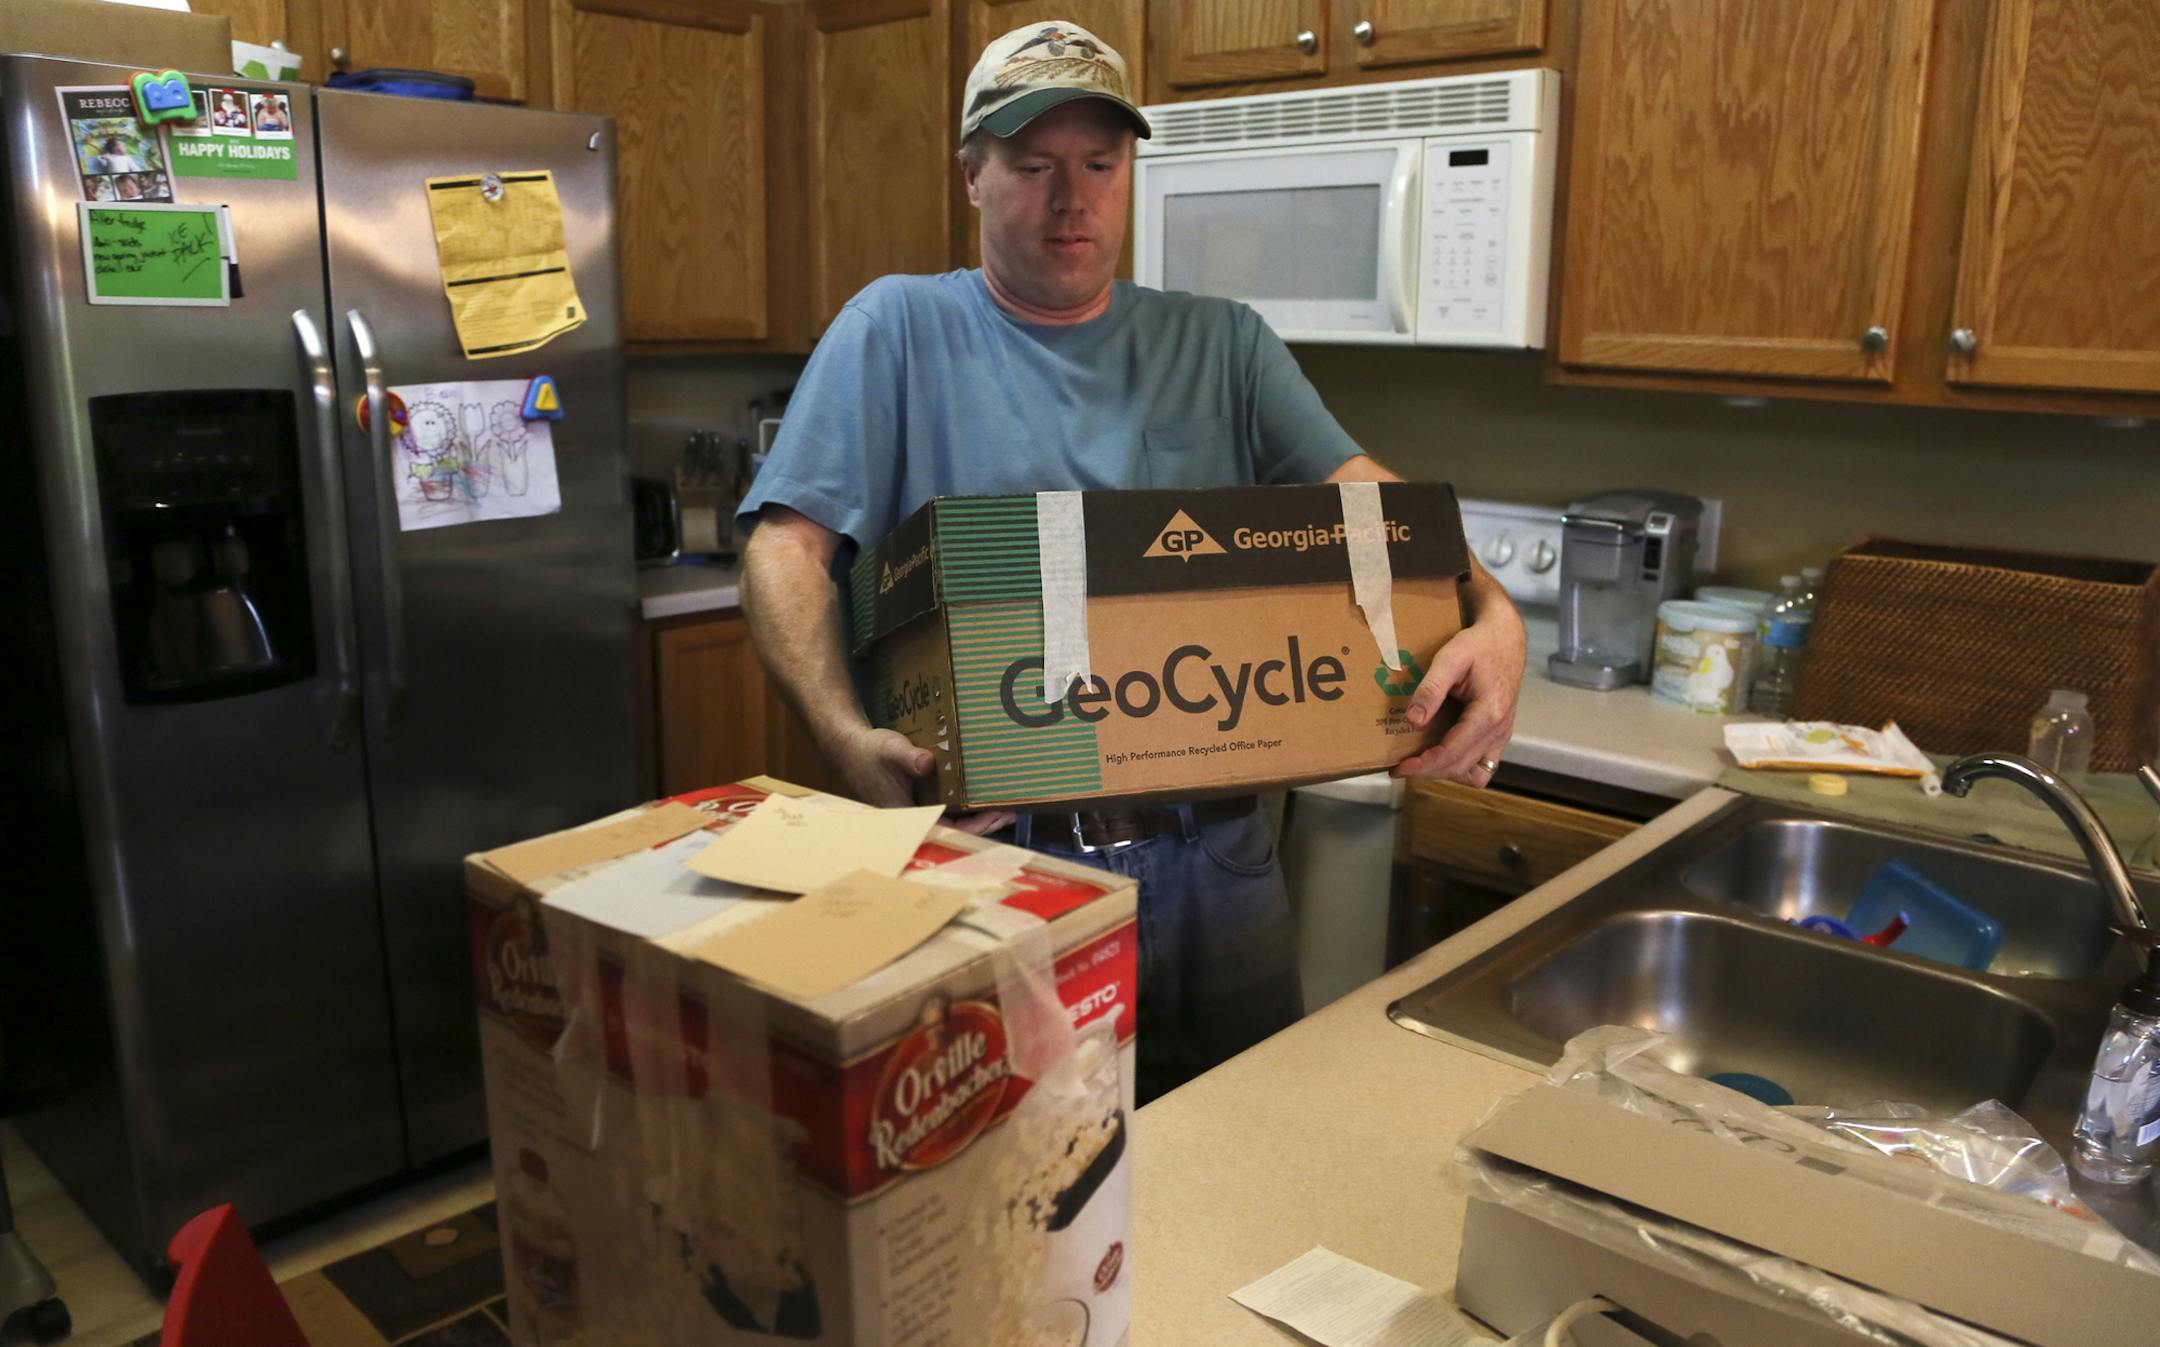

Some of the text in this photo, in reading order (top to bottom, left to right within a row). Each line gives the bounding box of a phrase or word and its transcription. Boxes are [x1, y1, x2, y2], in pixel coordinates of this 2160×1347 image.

[79, 98, 130, 109] REBECC
[179, 143, 291, 160] HAPPY HOLIDAYS
[1161, 521, 1411, 552] GP Georgia-Pacific
[1106, 739, 1282, 765] High Performance Recycled Office Paper
[895, 1032, 987, 1117] Orville
